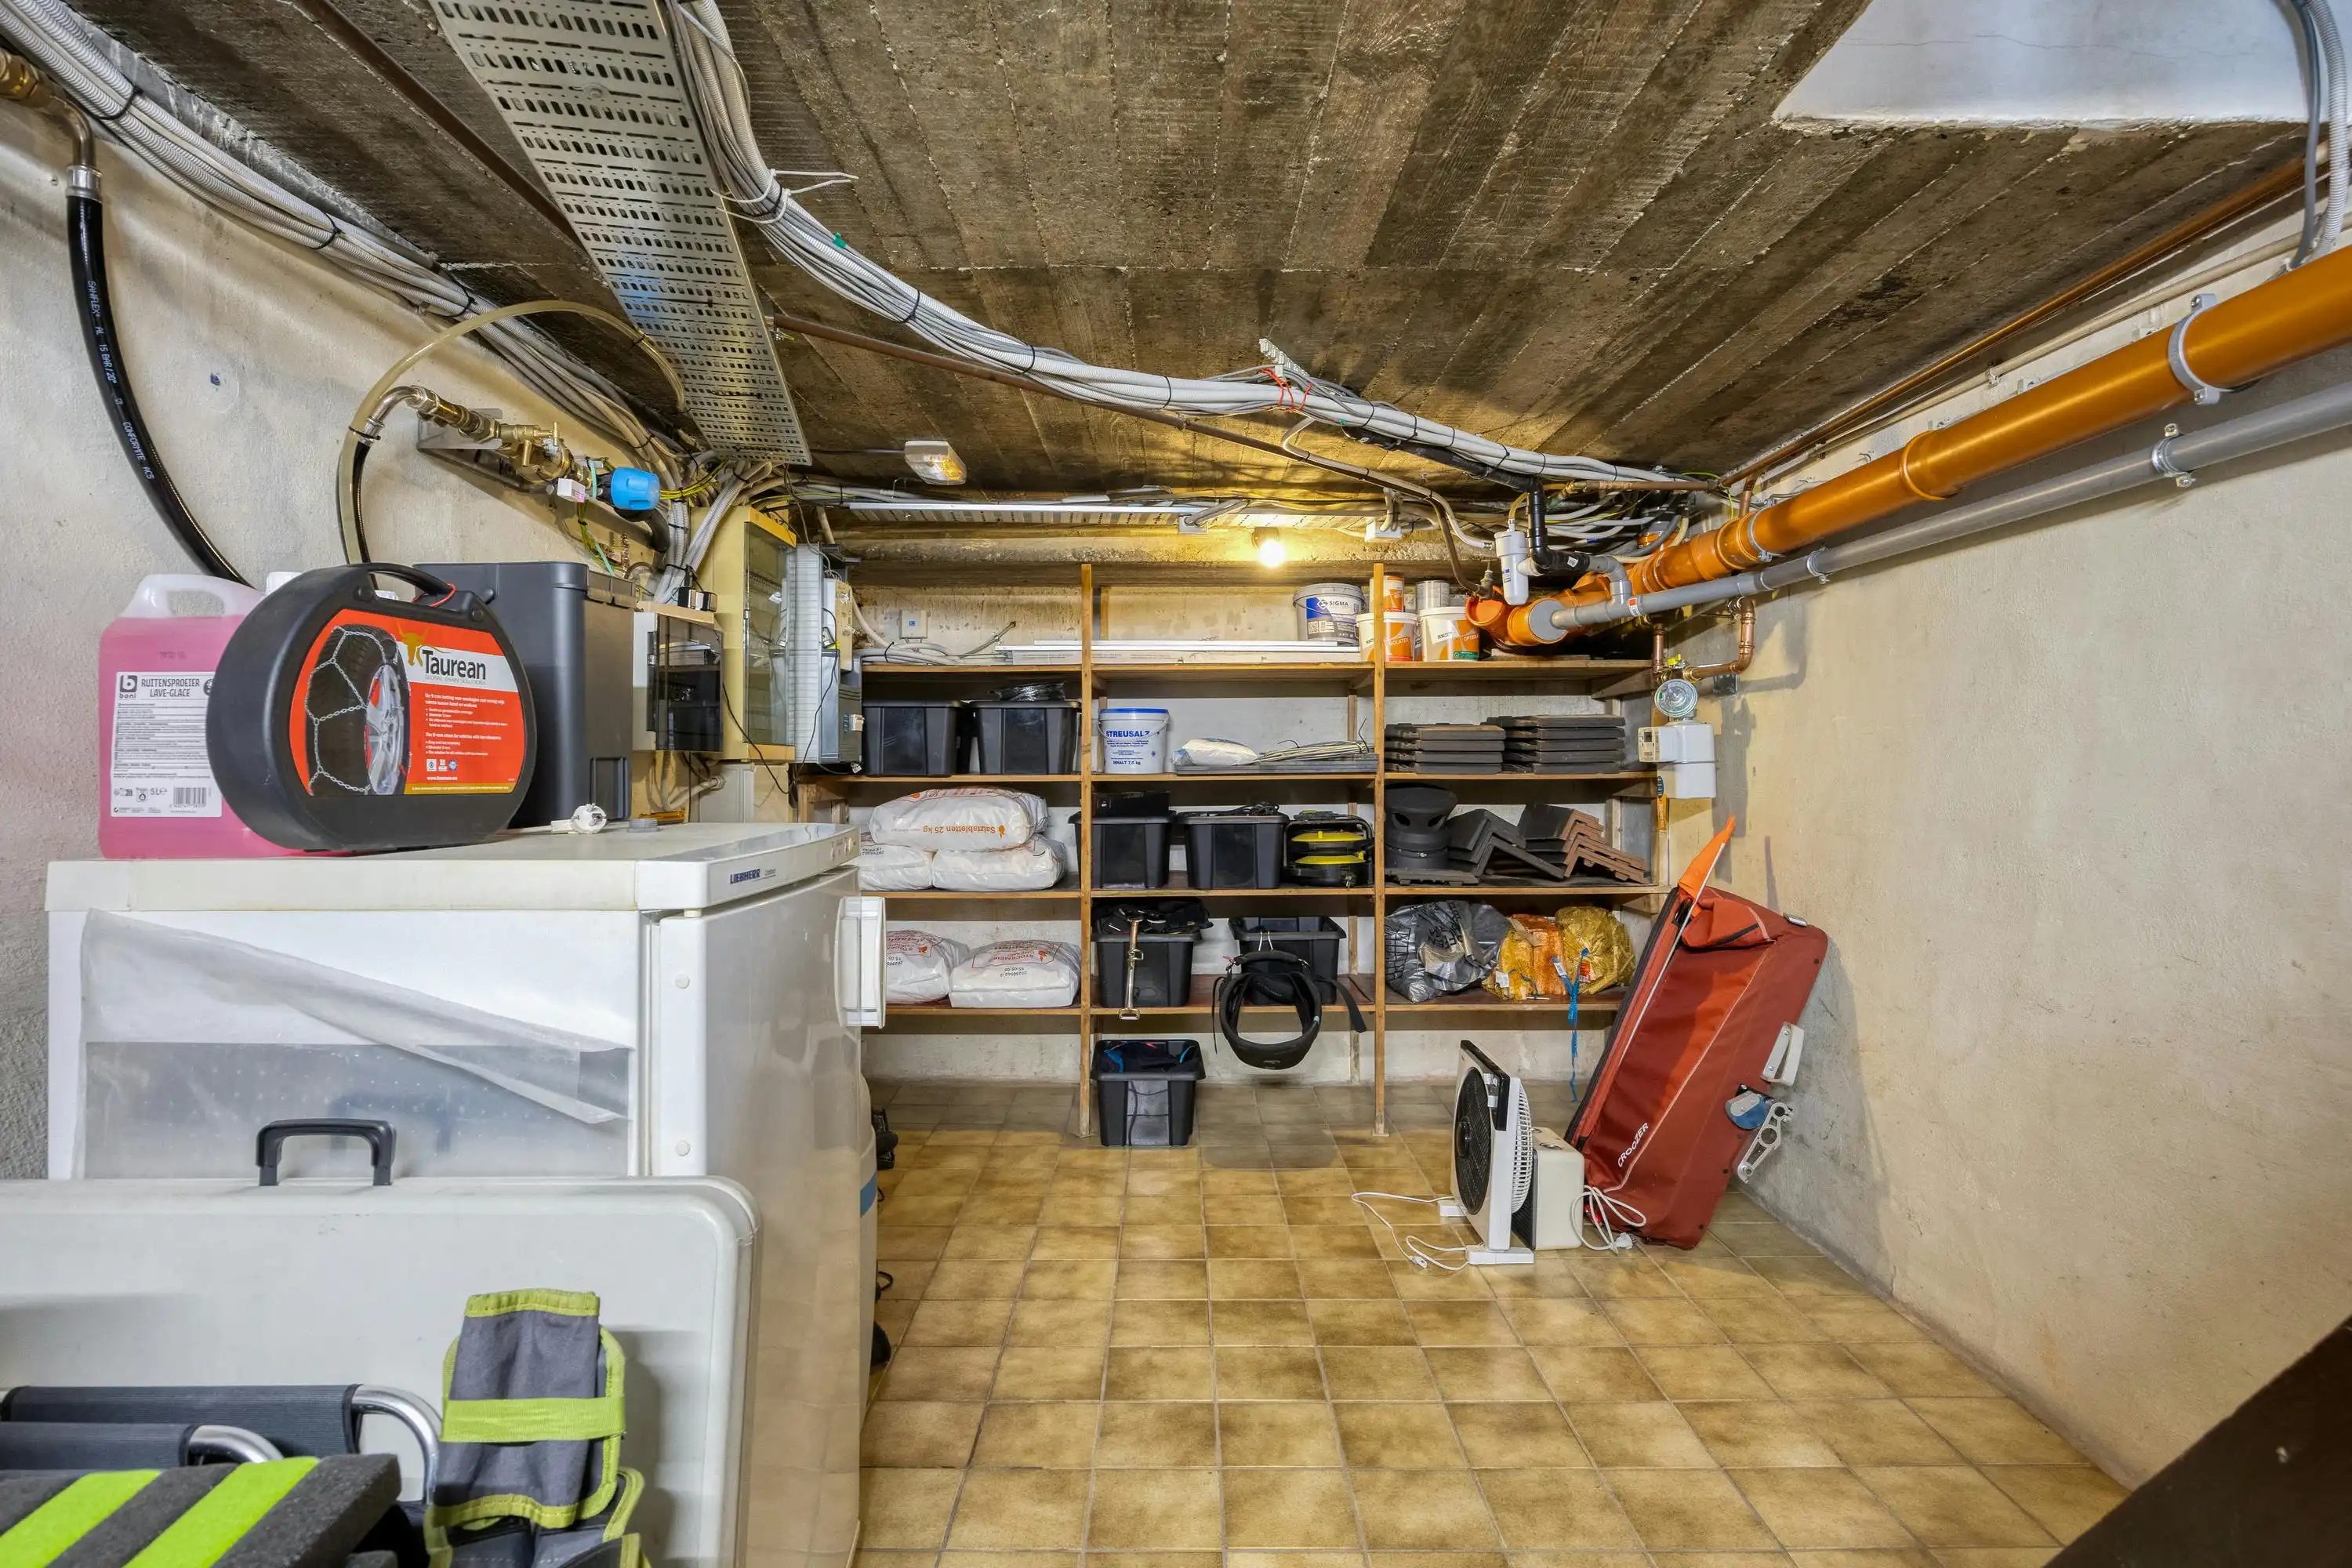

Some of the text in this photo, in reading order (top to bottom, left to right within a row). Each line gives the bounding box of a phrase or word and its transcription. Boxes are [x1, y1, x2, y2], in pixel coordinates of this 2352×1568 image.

[143, 466, 154, 480] ACS
[422, 649, 486, 680] Taurean
[140, 678, 201, 688] RUITENSPROEIER
[149, 688, 191, 698] LAVE-GLACE
[923, 826, 933, 834] kg
[946, 825, 996, 833] Salztabletten
[730, 868, 760, 884] LIEBHERR
[1617, 1122, 1649, 1167] CROOZER
